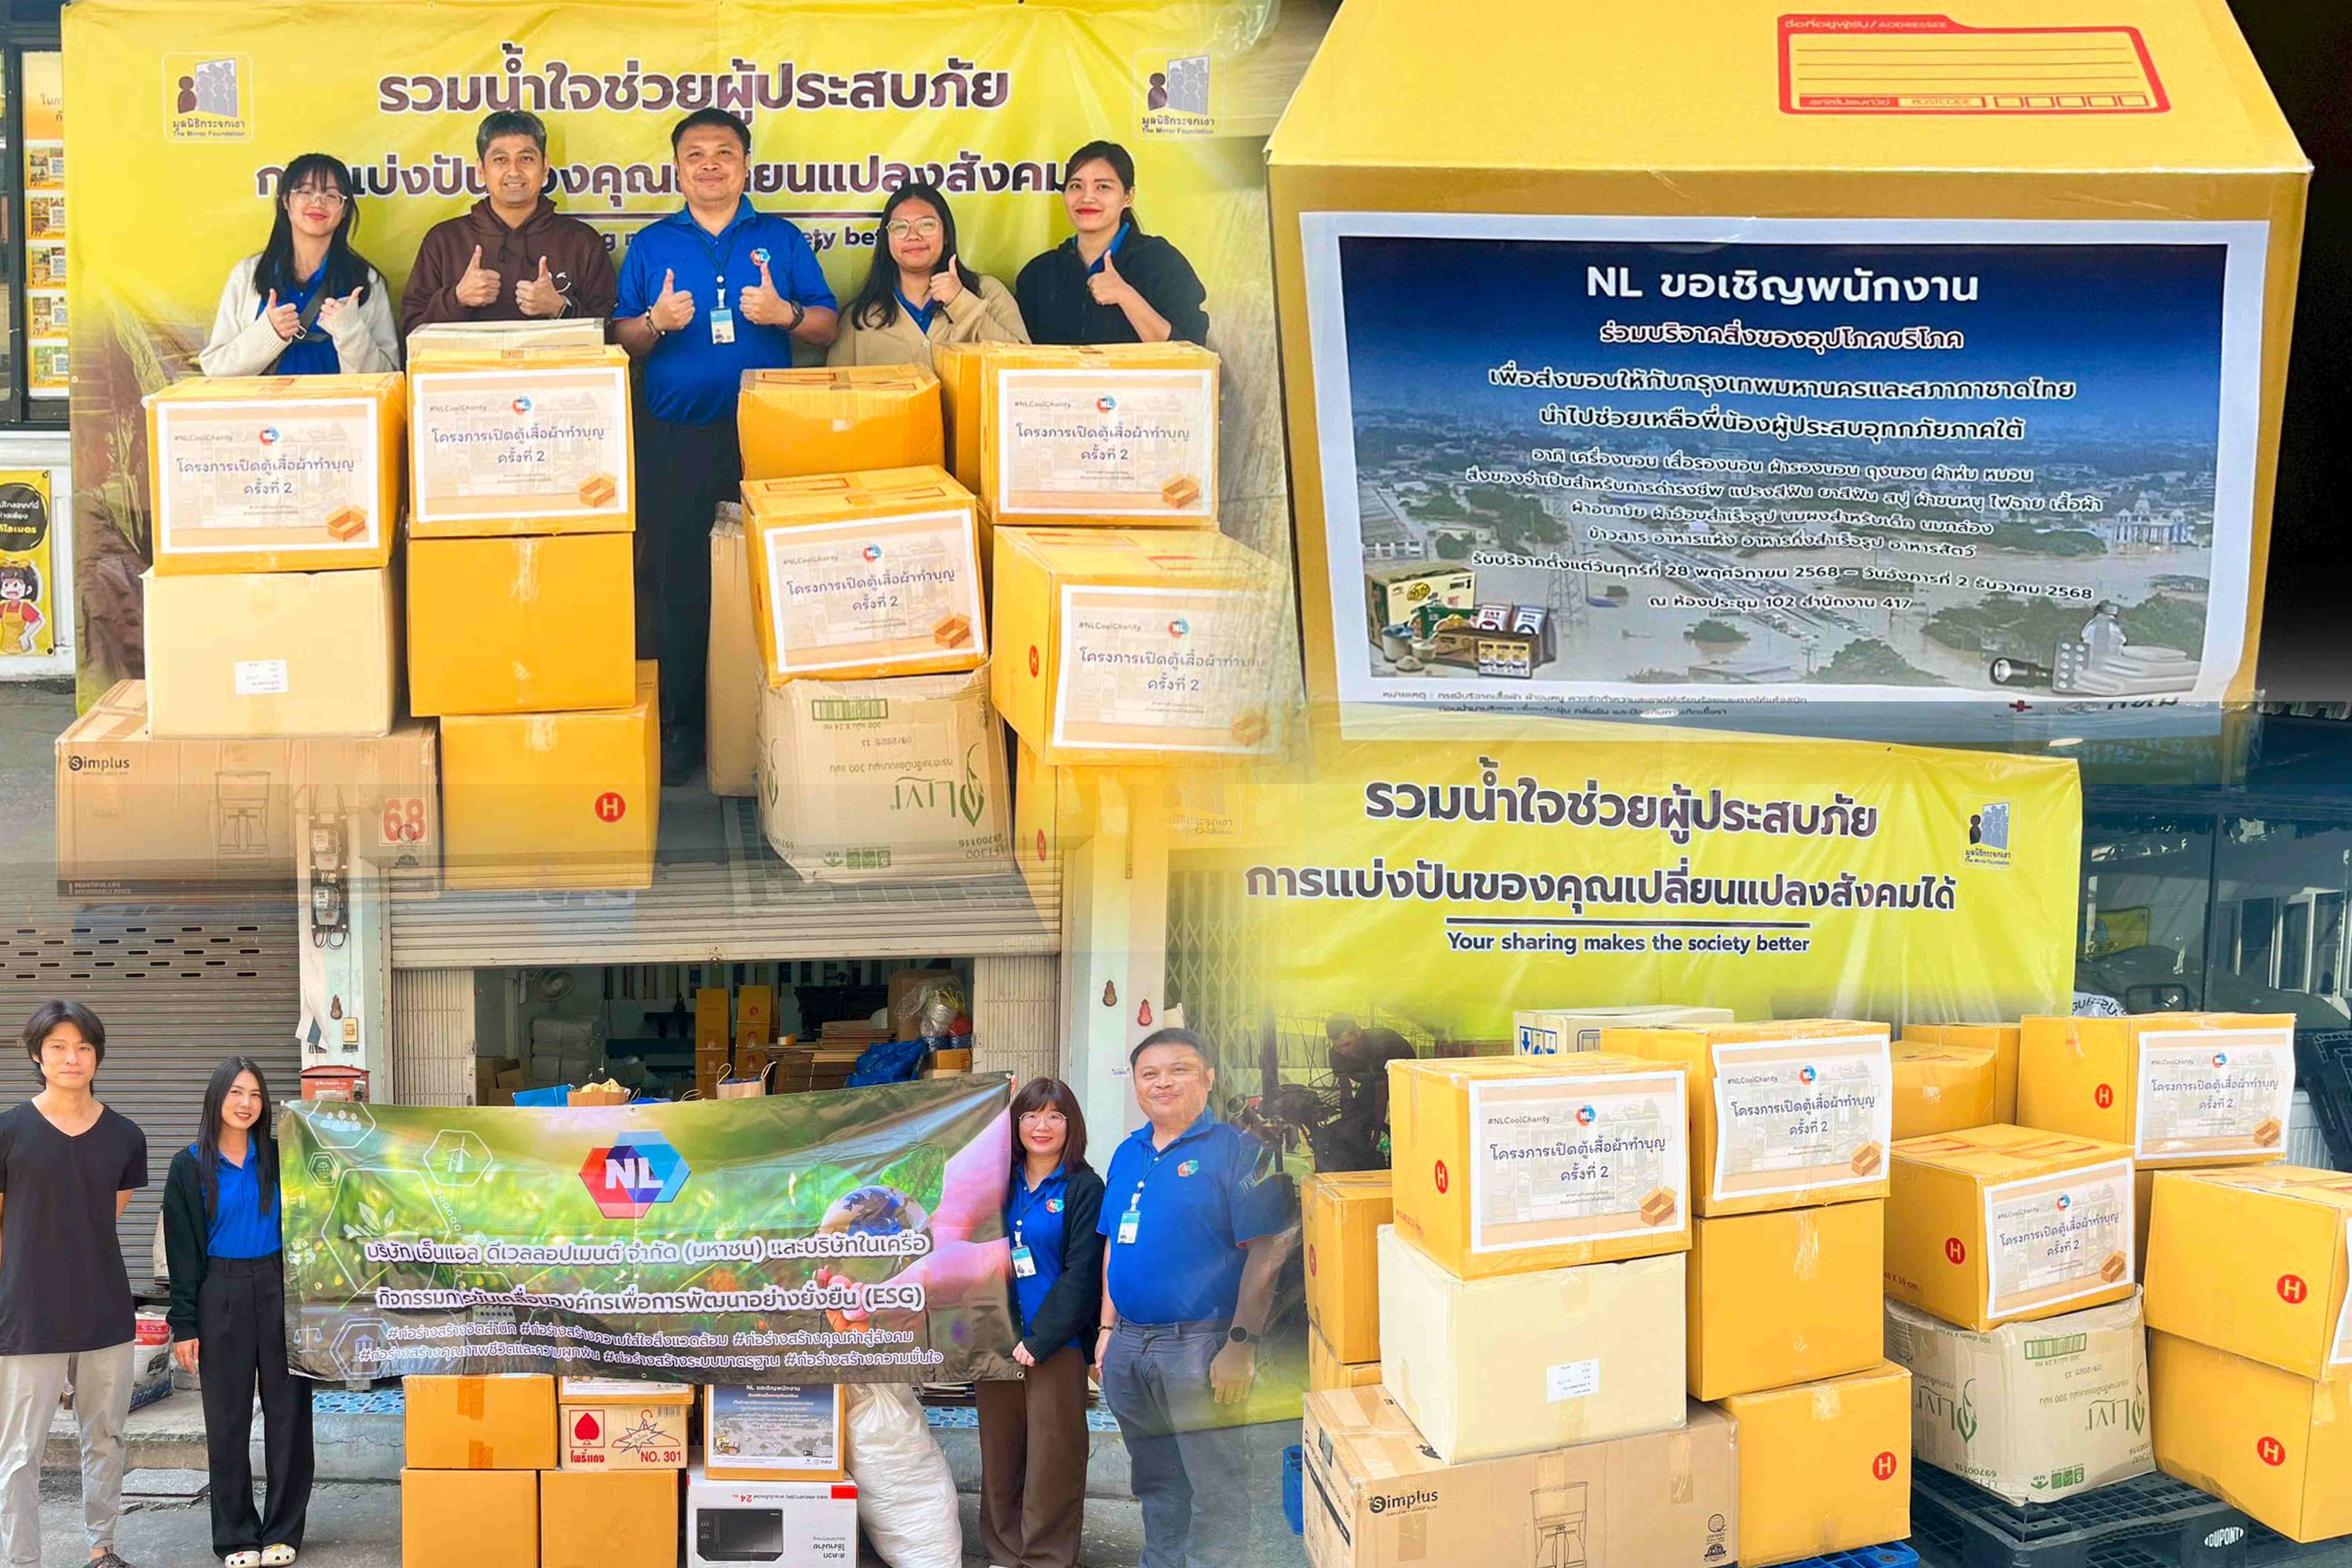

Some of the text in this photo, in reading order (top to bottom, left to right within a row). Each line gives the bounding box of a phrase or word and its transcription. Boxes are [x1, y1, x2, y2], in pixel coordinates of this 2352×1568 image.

[380, 43, 1008, 124] รวมน้ำใจช่วยผู้ประสบภัย
[173, 119, 245, 131] มูลนิธิกระจกเงา
[1588, 267, 1978, 305] NL ขอเชิญพนักงาน
[1601, 320, 1963, 354] ร่วมบริจาคสิ่งของอุปโภคบริโภค
[1489, 361, 2075, 400] เพื่อส่งมอบให้กับกรุงเทพมหานครและสภากาชาดไทย
[1540, 404, 2025, 444] นำไปช่วยเหลือพี่น้องผู้ประสบอุทกภัยภาคใต้
[537, 451, 545, 462] 2
[1120, 449, 1128, 460] 2
[1866, 465, 1926, 484] ถุงนอน
[1933, 465, 1978, 482] ผ้าห่ม
[1985, 468, 2034, 482] หมอน
[284, 482, 293, 494] 2
[1990, 494, 2044, 510] ไฟฉาย
[1589, 526, 1646, 543] ข้าวสาร
[1920, 516, 1994, 535] นมกล่อง
[1667, 565, 1688, 577] 28
[1794, 566, 1839, 579] 2568
[1957, 575, 1968, 588] 2
[2046, 584, 2092, 599] 2568
[890, 596, 898, 607] 2
[1650, 594, 1913, 613] ณ ห้องประชุม 102 สำนักงาน 417
[1191, 679, 1199, 691] 2
[68, 755, 130, 771] Simplus
[1366, 757, 1877, 844] รวมน้ำใจช่วยผู้ประสบภัย
[383, 799, 426, 842] 68
[1246, 858, 1956, 914] การแบ่งปันของคุณเปลี่ยนแปลงสังคมได้
[1448, 931, 1810, 955] Your sharing makes the society better
[2227, 1098, 2233, 1108] 2
[1488, 1114, 1550, 1125] #NLCoolCharity
[1821, 1121, 1828, 1132] 2
[1490, 1135, 1666, 1161] โครงการเปิดตู้เสื้อผ้าทำบุญ
[606, 1157, 663, 1189] NL
[1561, 1163, 1608, 1183] ครั้งที่ 2
[366, 1232, 929, 1262] บริษัท เอ็นแอล ดีเวลลอปเมนต์ จำกัด (มหาชน) และบริษัทในเครือ
[2073, 1240, 2080, 1250] 2
[865, 1286, 923, 1310] (ESG)
[570, 1449, 605, 1463] โพธิ์แดง
[641, 1451, 681, 1462] NO. 301
[1369, 1491, 1438, 1513] Simplus
[2208, 1526, 2240, 1547] DUPONT
